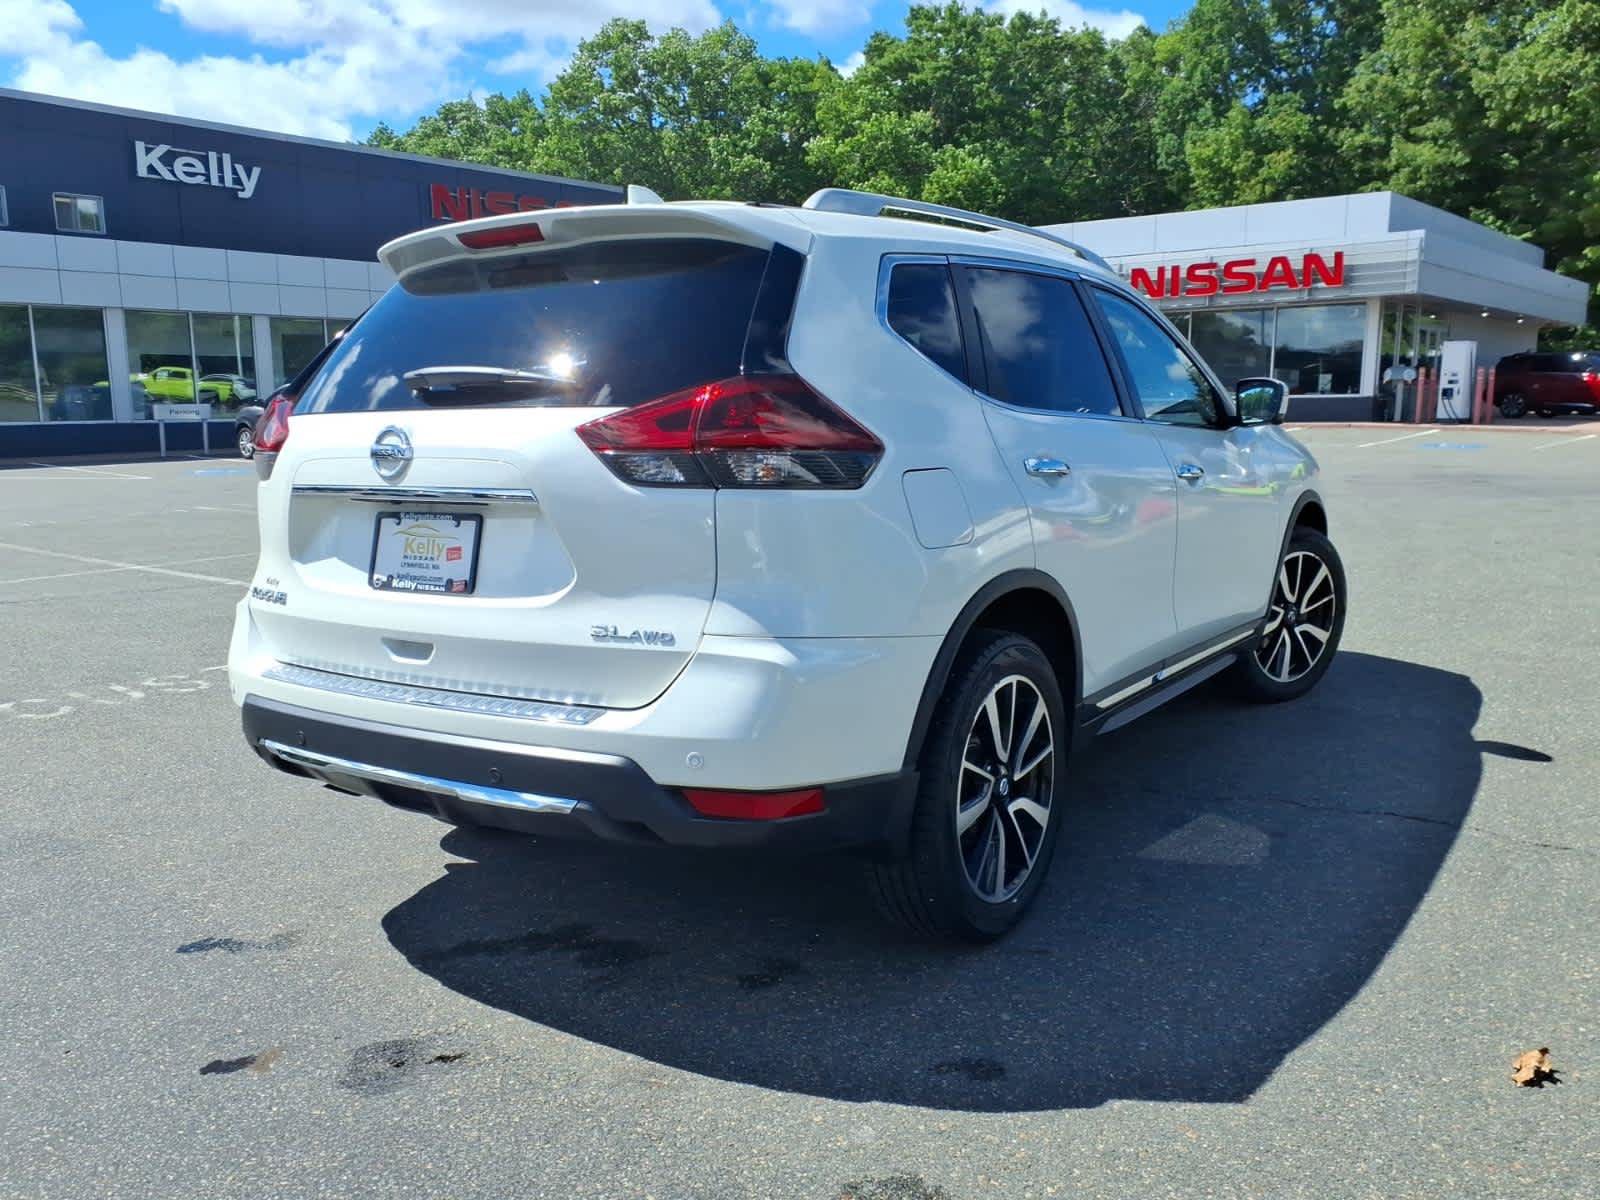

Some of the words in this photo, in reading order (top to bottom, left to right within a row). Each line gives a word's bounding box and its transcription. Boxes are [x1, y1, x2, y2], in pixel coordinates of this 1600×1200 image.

[135, 140, 262, 199] Kelly
[1130, 250, 1345, 299] NISSAN
[404, 537, 445, 560] Kelly
[392, 579, 417, 591] Kelly
[416, 583, 446, 592] NISSAN
